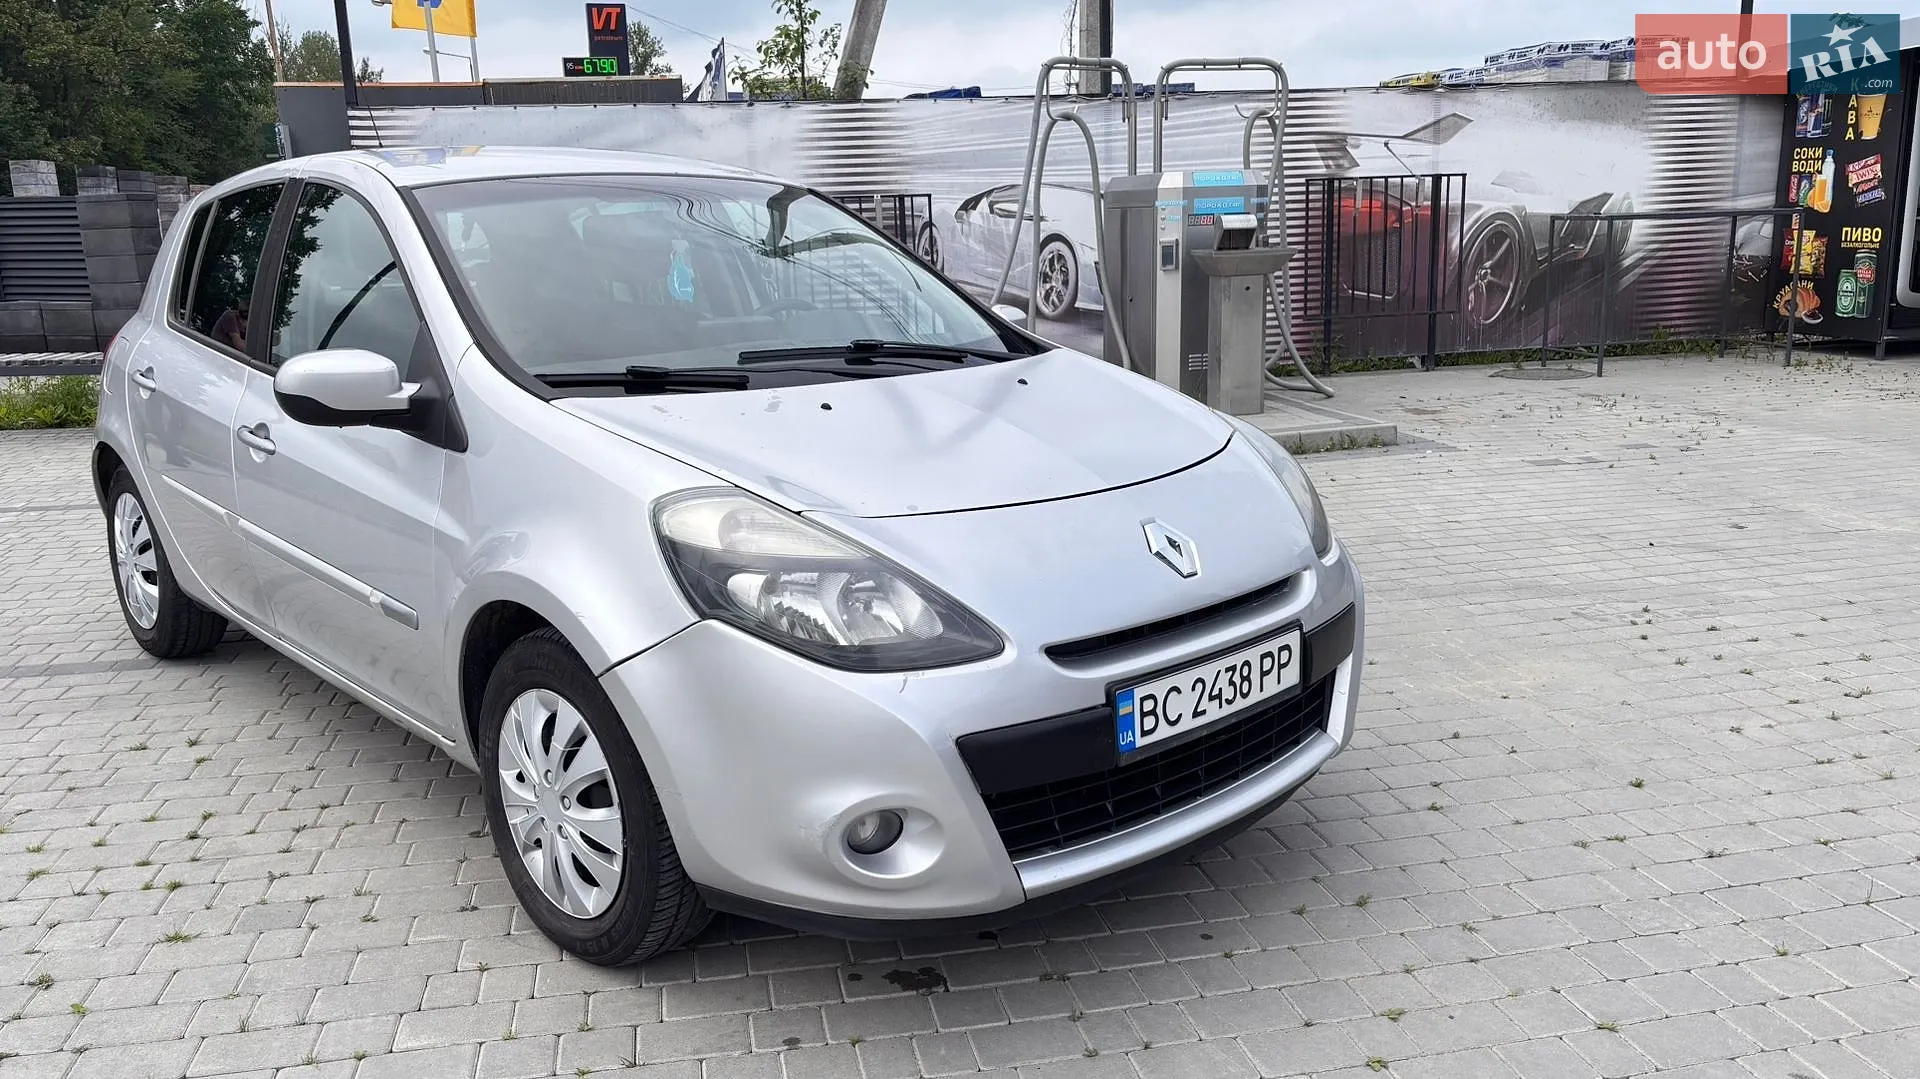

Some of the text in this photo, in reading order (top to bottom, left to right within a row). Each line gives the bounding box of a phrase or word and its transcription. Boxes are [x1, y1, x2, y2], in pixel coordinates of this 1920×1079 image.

[592, 8, 620, 30] VT
[1793, 147, 1823, 160] СОКИ
[1792, 160, 1822, 174] ВОДИ
[1841, 227, 1882, 242] ПИВО
[1139, 643, 1293, 737] BC 2438 PP
[1119, 730, 1134, 745] UA
